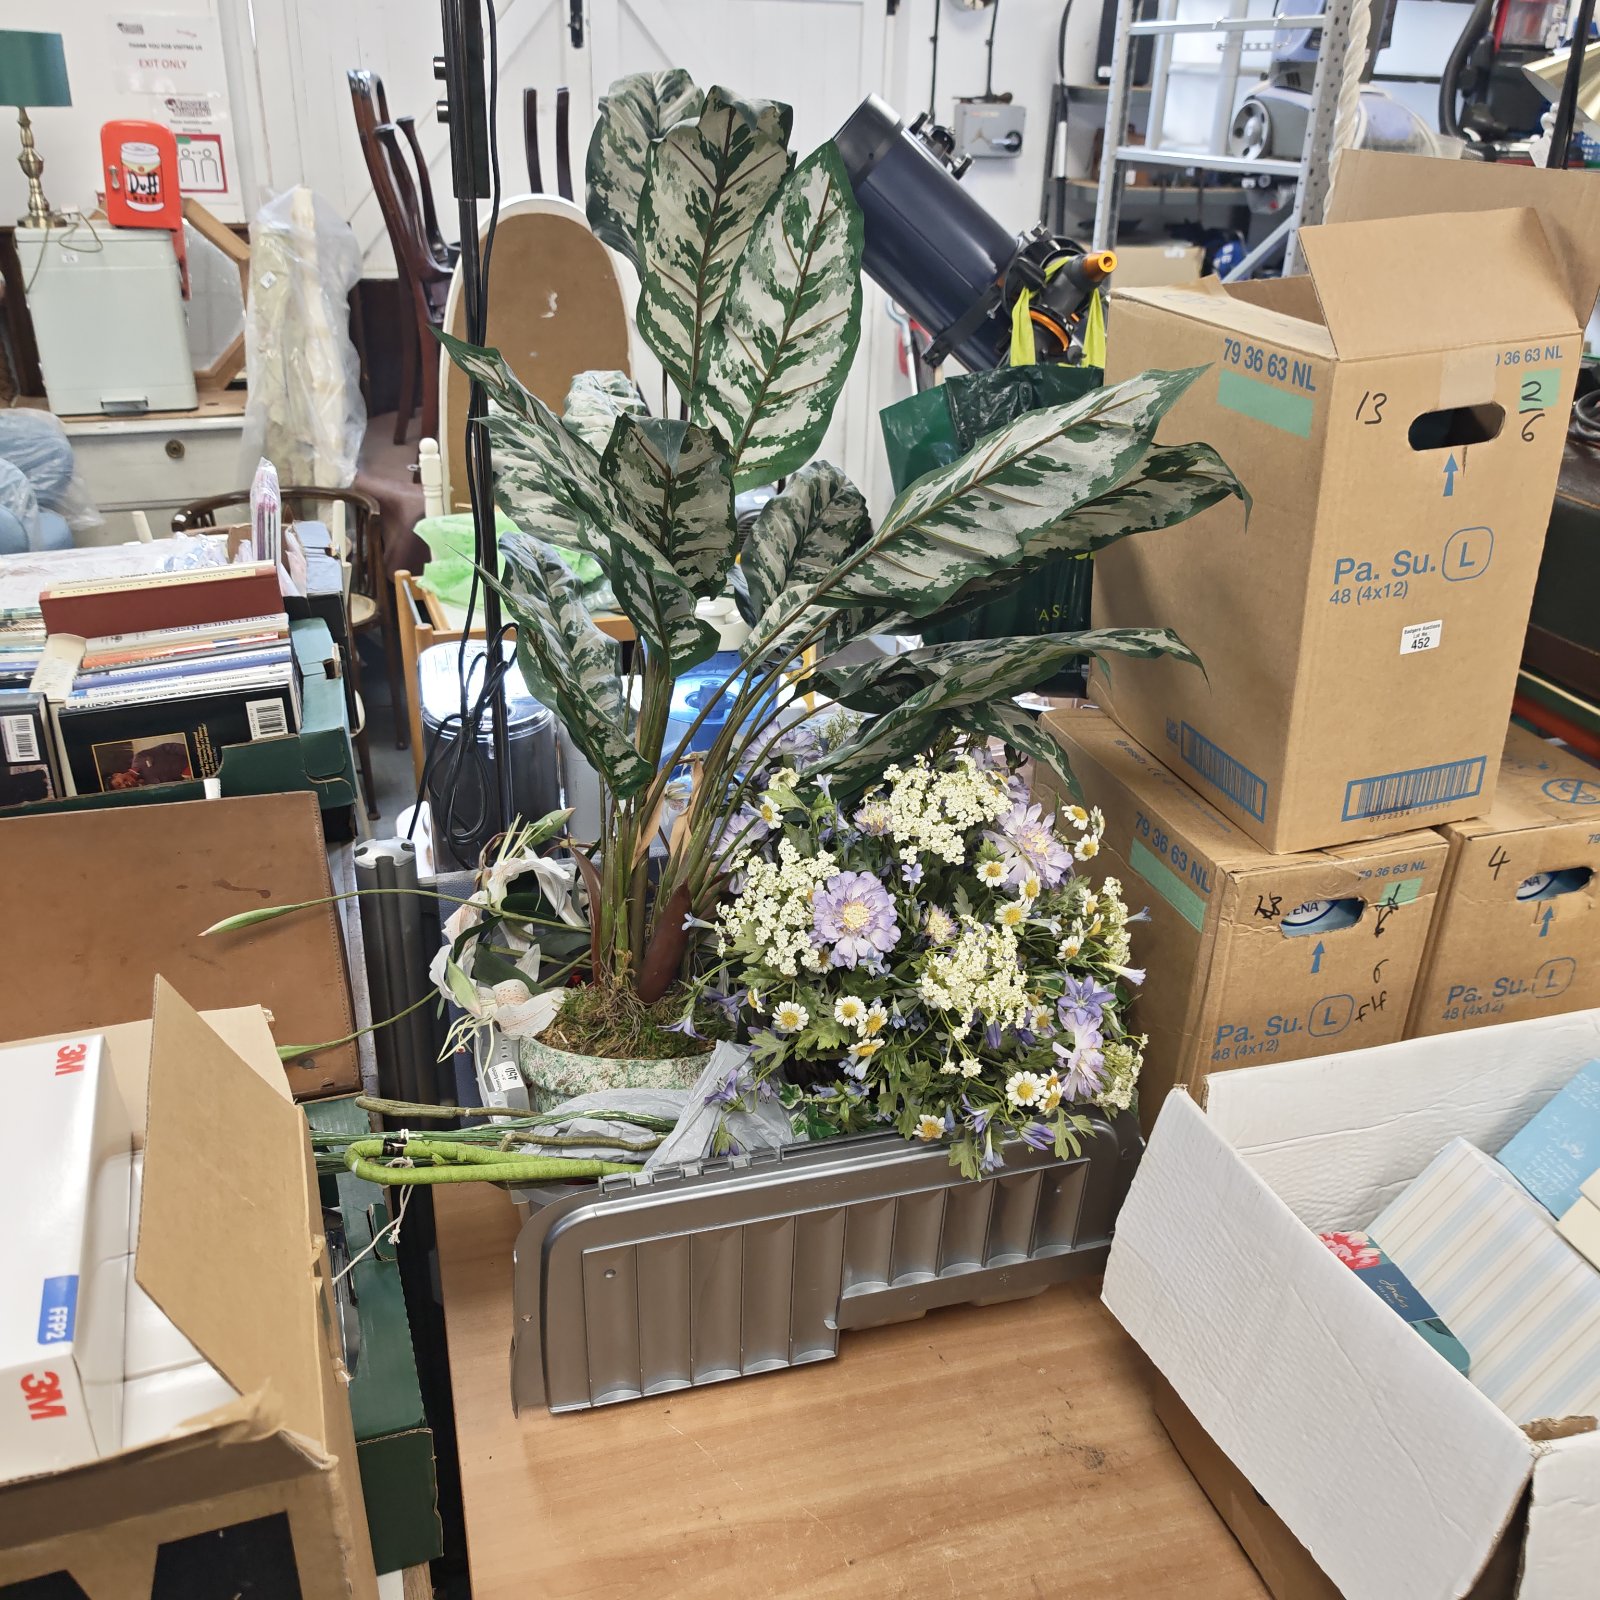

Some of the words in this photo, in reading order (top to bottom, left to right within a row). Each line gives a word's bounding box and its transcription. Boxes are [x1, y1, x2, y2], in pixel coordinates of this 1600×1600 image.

[139, 58, 158, 68] EXIT
[162, 60, 187, 69] ONLY
[1223, 338, 1241, 364] 79
[1244, 346, 1264, 372] 36
[1267, 353, 1288, 381] 63
[1291, 361, 1316, 391] NL
[1503, 350, 1520, 365] 36
[1524, 348, 1541, 363] 63
[1544, 345, 1563, 360] NL
[1355, 391, 1387, 425] 13
[1333, 557, 1380, 585] Pa.
[1391, 550, 1436, 577] Su.
[1459, 542, 1475, 567] L
[1329, 588, 1351, 605] 48
[1356, 580, 1409, 605] (4x12)
[1411, 636, 1430, 650] 452
[1135, 811, 1150, 837] 79
[1152, 828, 1168, 854] 36
[1171, 844, 1187, 872] 63
[1190, 860, 1212, 894] NL
[1487, 845, 1511, 881] 4
[1375, 868, 1390, 877] 36
[1392, 863, 1409, 875] 63
[1410, 860, 1427, 871] NL
[1447, 985, 1482, 1005] Pa.
[1492, 977, 1528, 997] Su.
[1546, 969, 1557, 988] L
[1323, 1007, 1337, 1026] L
[1442, 1008, 1459, 1020] 48
[1462, 1001, 1504, 1020] (4x12)
[1216, 1024, 1254, 1045] Pa.
[1264, 1015, 1303, 1036] Su.
[55, 1044, 87, 1076] 3M
[1211, 1048, 1230, 1061] 48
[1235, 1039, 1279, 1059] (4x12)
[46, 1306, 68, 1341] FFP2
[20, 1371, 67, 1420] 3M
